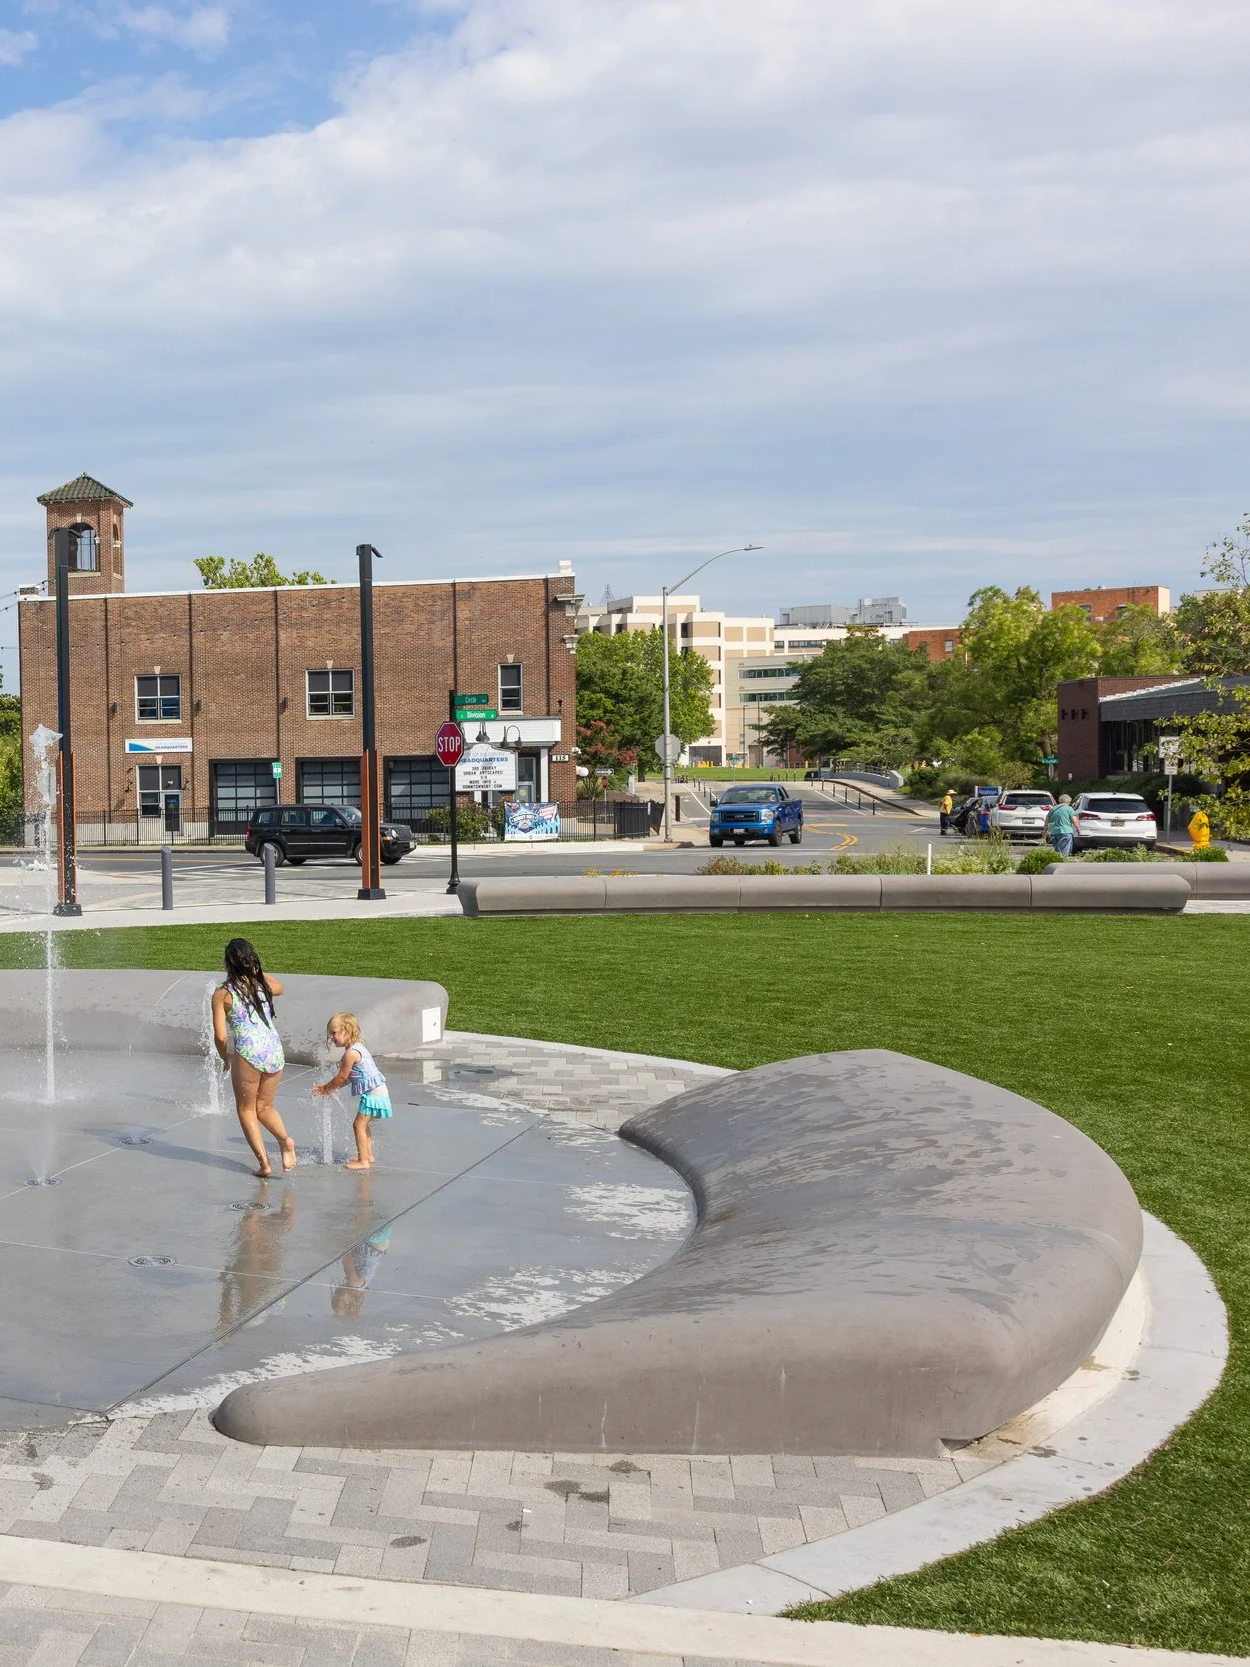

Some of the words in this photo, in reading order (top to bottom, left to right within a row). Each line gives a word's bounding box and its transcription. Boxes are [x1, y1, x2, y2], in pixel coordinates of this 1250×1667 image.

[464, 696, 477, 704] Circle
[466, 711, 486, 719] Division
[438, 736, 461, 753] STOP
